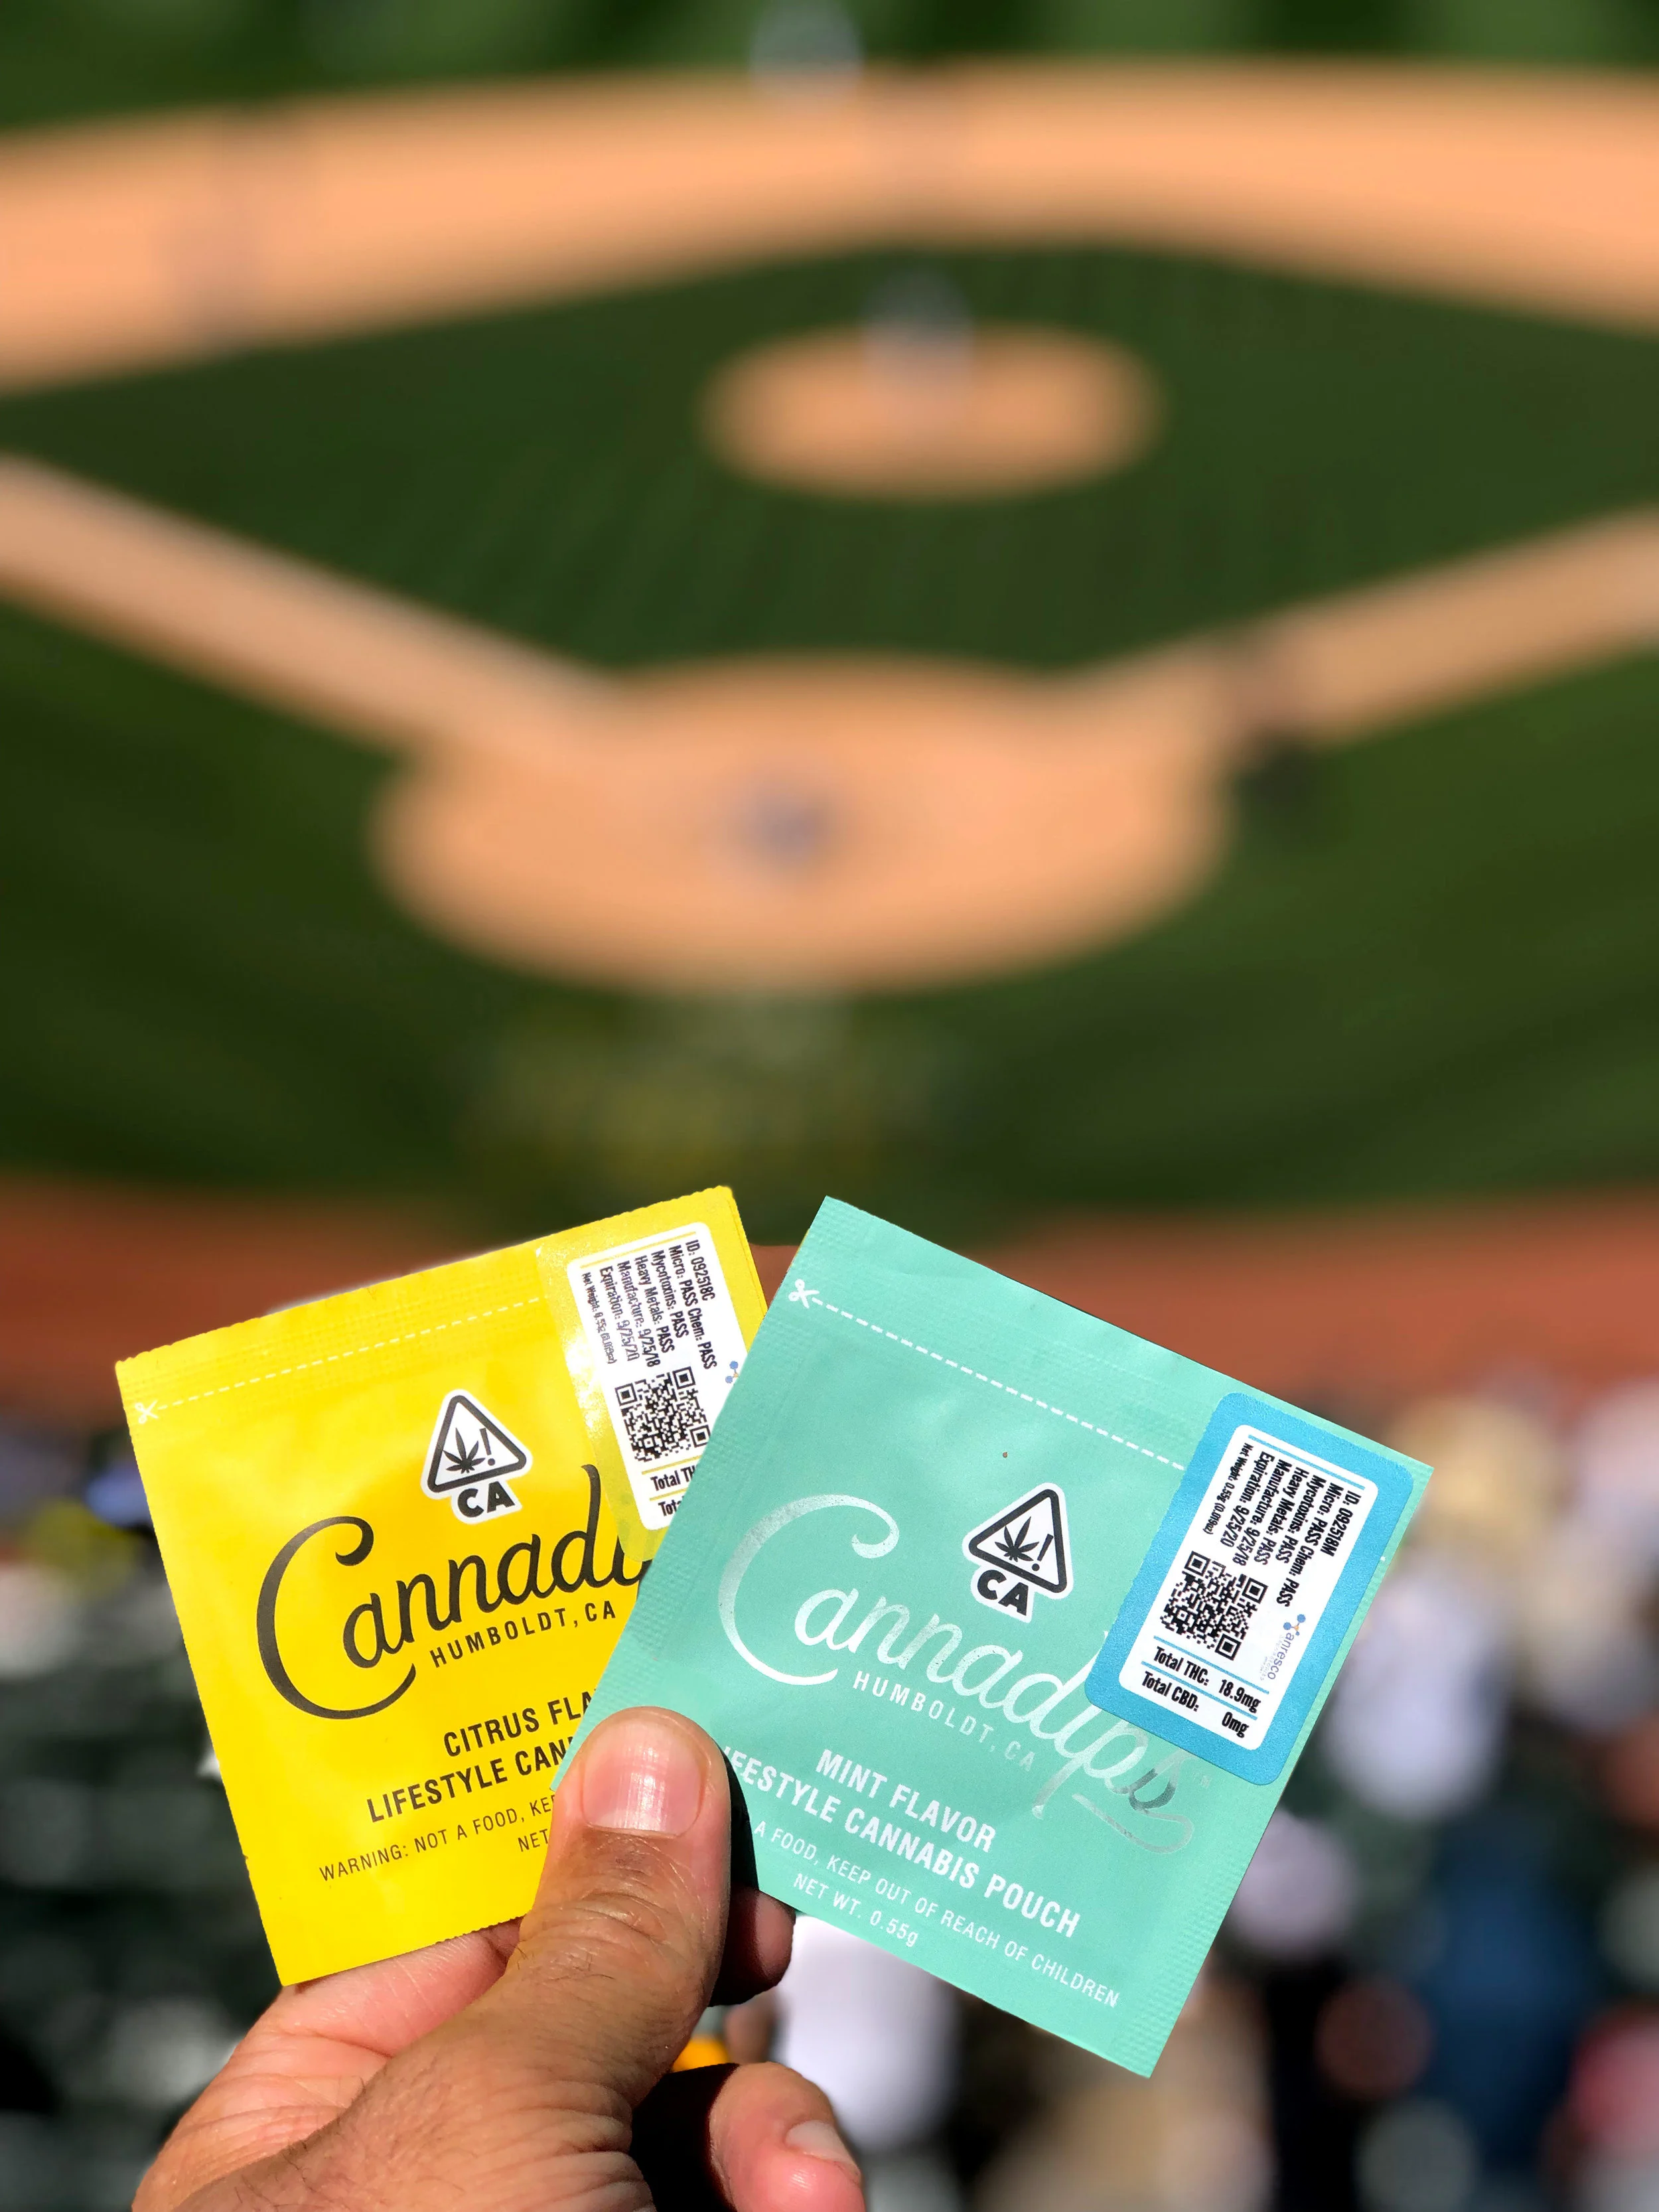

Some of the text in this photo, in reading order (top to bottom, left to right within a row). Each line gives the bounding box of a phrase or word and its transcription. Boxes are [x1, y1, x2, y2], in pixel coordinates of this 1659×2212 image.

[634, 1254, 675, 1353] Heavy Metals: PASS
[650, 1249, 689, 1338] Mycotoxins: PASS
[668, 1244, 717, 1369] Micro: PASS Chem: PASS
[685, 1239, 715, 1301] ID: 092518C
[599, 1265, 640, 1361] Expiration: 9/25/20
[616, 1260, 660, 1367] Manufacture: 9/25/18
[650, 1465, 695, 1491] Total TH
[1228, 1456, 1248, 1481] Weight:
[1239, 1442, 1254, 1457] Net
[457, 1481, 516, 1518] CA
[658, 1498, 683, 1516] Tot
[1216, 1481, 1235, 1503] 0.55g
[1220, 1451, 1275, 1547] Expiration: 9/25/20
[1232, 1459, 1292, 1566] Manufacture: 9/25/18
[1253, 1466, 1309, 1565] Heavy Metals: PASS
[1275, 1474, 1327, 1564] Mycotoxins: PASS
[1319, 1490, 1361, 1556] ID: 092518M
[1275, 1482, 1344, 1607] Micro: PASS Chem: PASS
[256, 1464, 652, 1719] Cannadi
[977, 1570, 1031, 1617] CA
[429, 1600, 614, 1667] HUMBOLDT, CA
[1267, 1632, 1294, 1679] anresco
[1141, 1670, 1249, 1737] Total CBD: 0mg
[1153, 1646, 1261, 1713] Total THC: 18.9mg
[444, 1689, 595, 1756] CITRUS FLA
[853, 1670, 1035, 1771] HUMBOLDT, CA
[367, 1736, 573, 1821] LIFESTYLE CAN
[816, 1749, 995, 1852] MINT FLAVOR
[319, 1842, 409, 1880] WARNING:
[414, 1830, 447, 1852] NOT
[458, 1825, 469, 1840] A
[473, 1808, 524, 1833] FOOD,
[518, 1828, 549, 1851] NET
[844, 1807, 979, 1888] CANNABIS
[983, 1873, 1080, 1937] POUCH
[753, 1820, 1119, 2007] A FOOD, KEEP OUT OF REACH OF CHILDREN
[793, 1872, 918, 1947] NET WT. 0.55g
